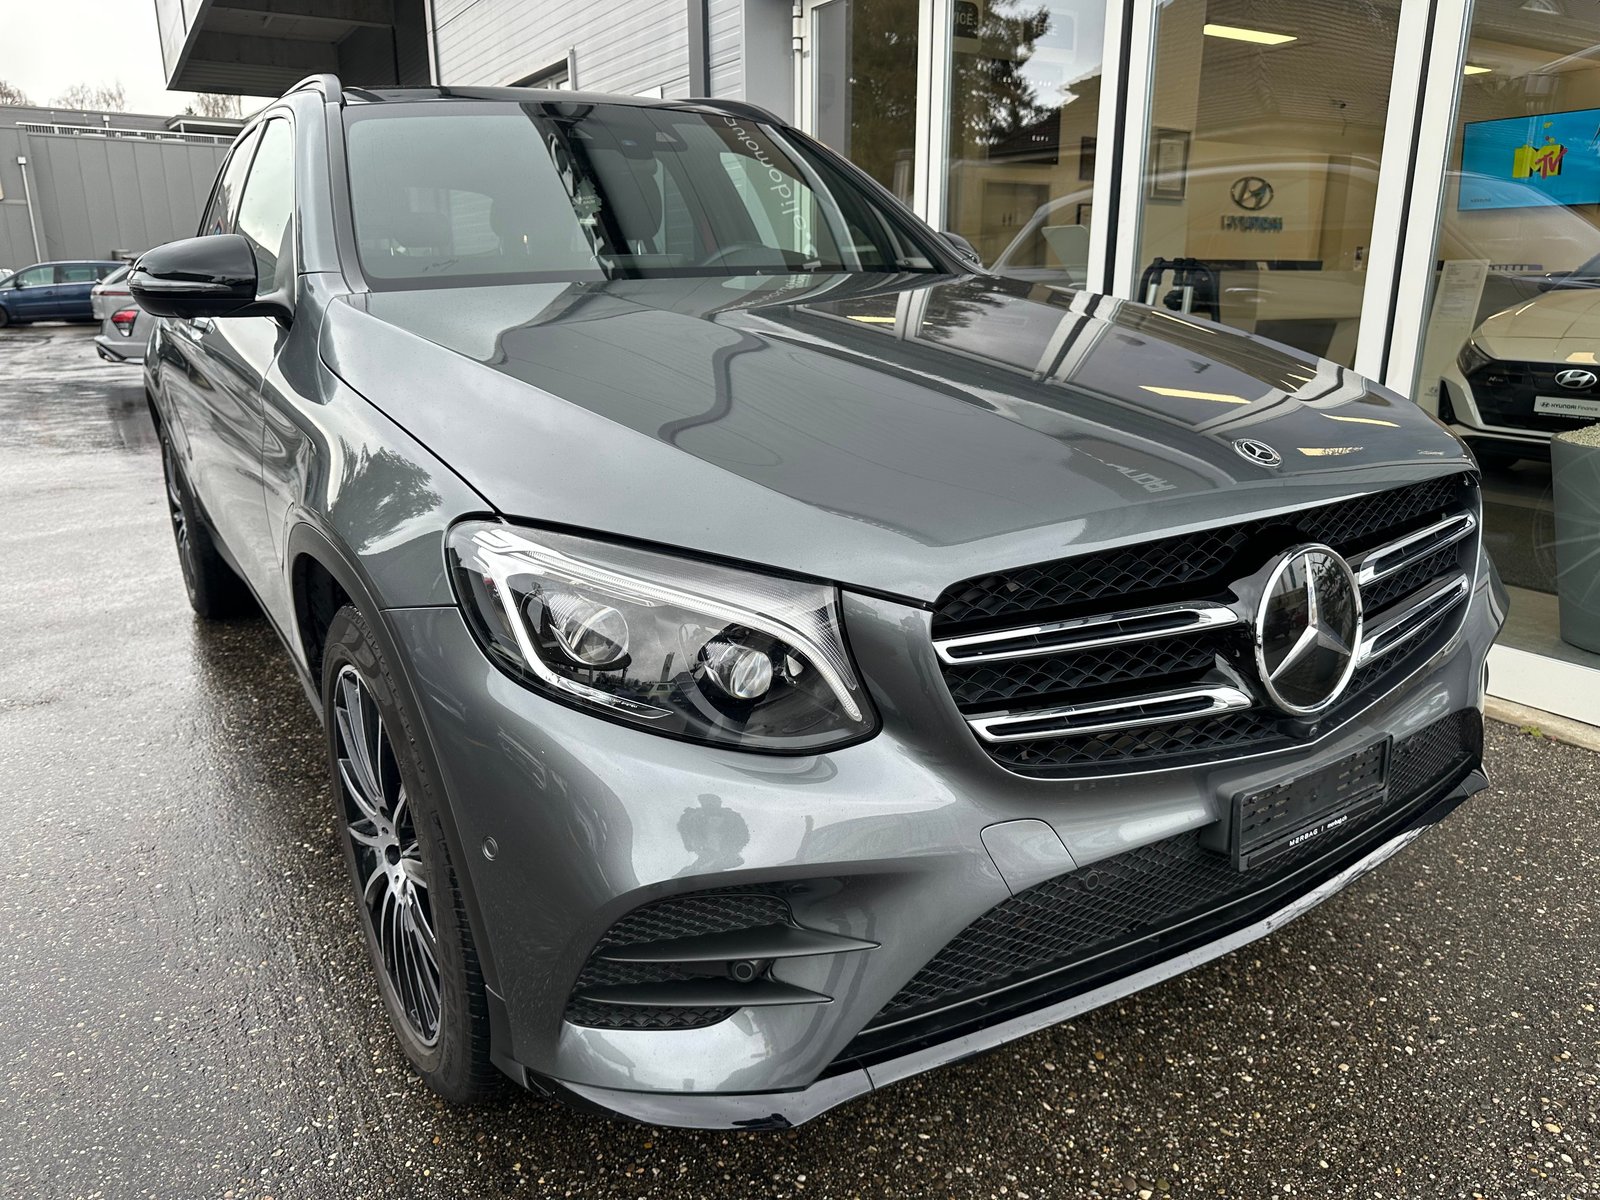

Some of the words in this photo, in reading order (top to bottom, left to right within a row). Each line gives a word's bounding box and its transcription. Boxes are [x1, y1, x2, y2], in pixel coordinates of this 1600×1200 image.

[1512, 144, 1568, 180] MTV
[1220, 215, 1284, 234] HYUNDAI
[1289, 828, 1318, 846] MERBAG
